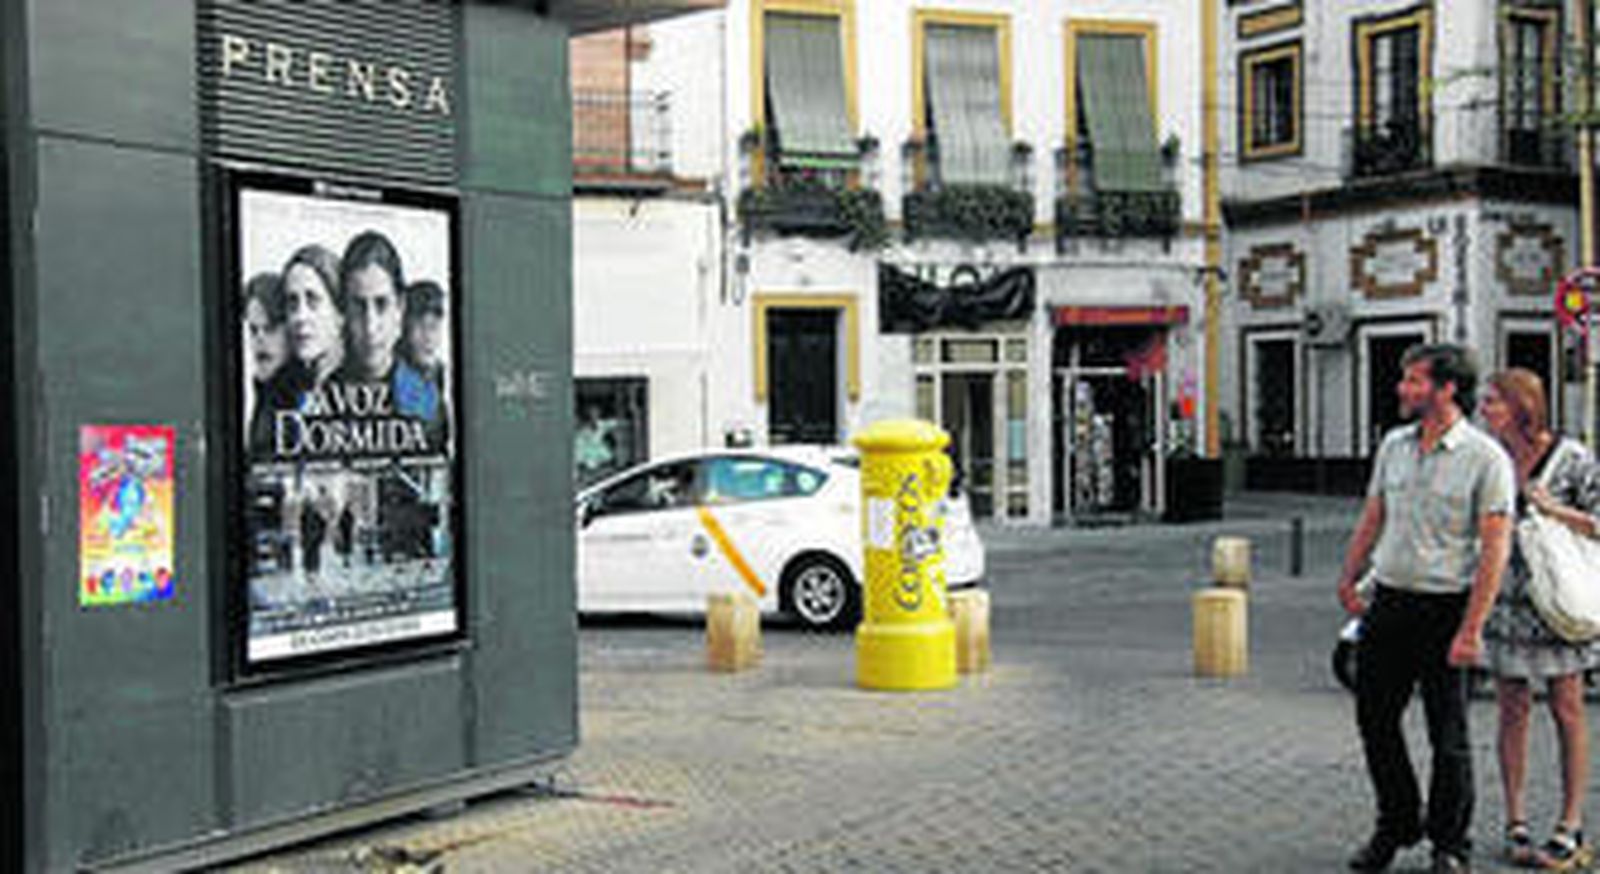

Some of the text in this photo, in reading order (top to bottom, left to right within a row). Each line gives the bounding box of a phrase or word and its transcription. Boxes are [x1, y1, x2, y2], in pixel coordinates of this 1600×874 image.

[222, 34, 450, 115] PRENSA
[329, 382, 392, 416] VOZ
[274, 410, 429, 456] DORMIDA
